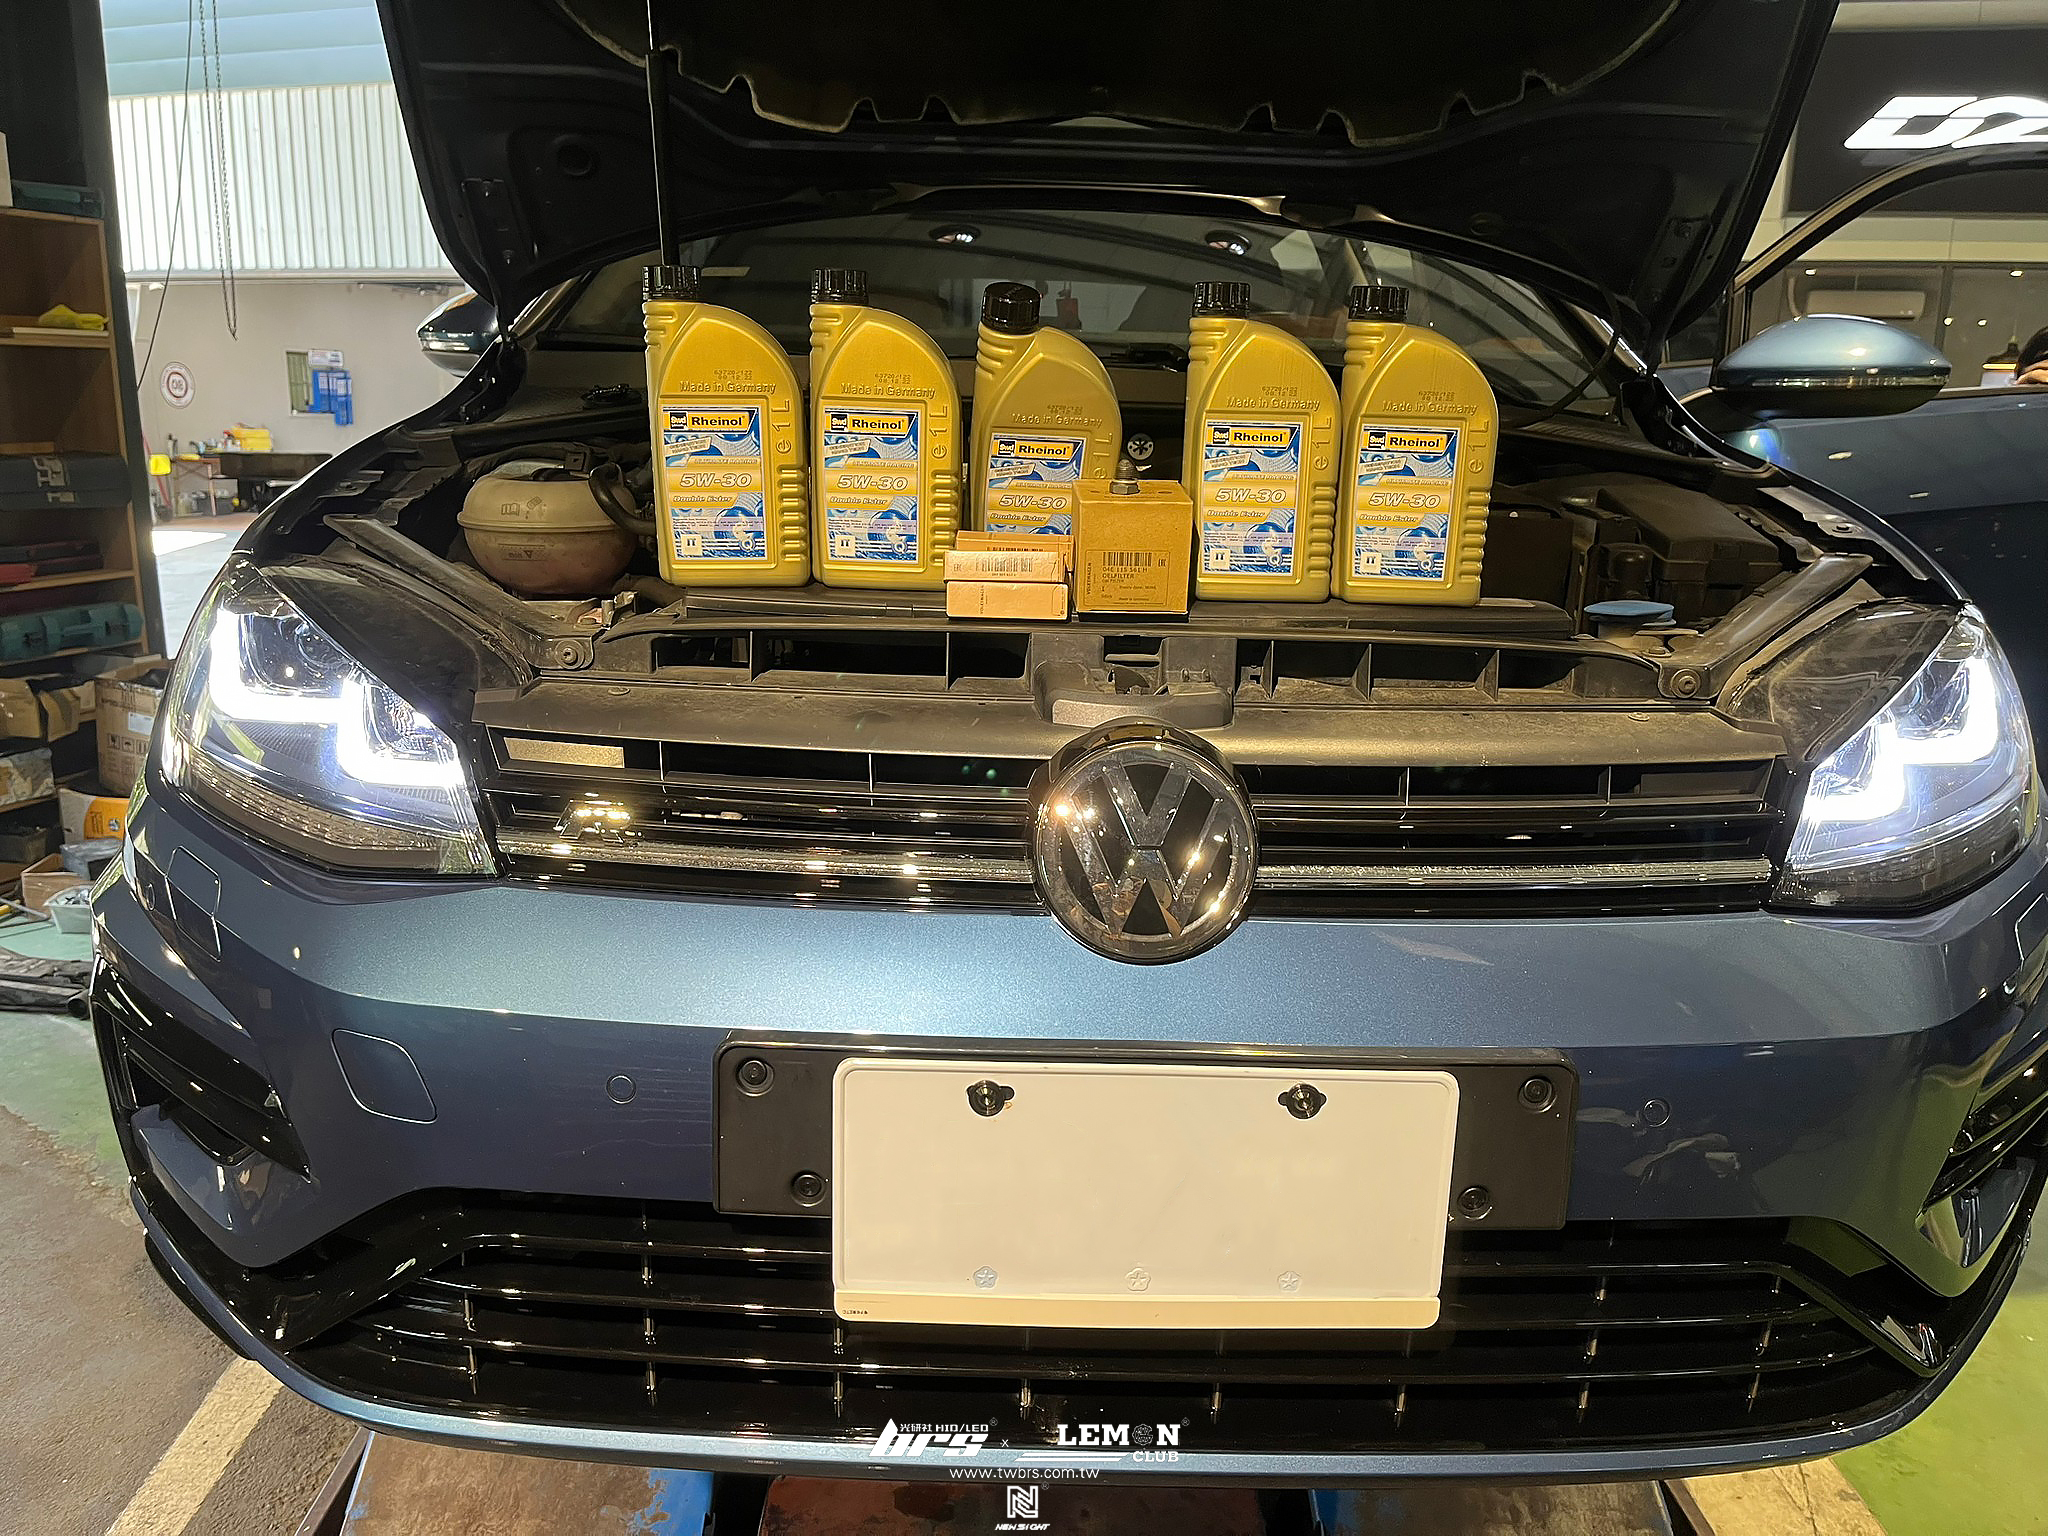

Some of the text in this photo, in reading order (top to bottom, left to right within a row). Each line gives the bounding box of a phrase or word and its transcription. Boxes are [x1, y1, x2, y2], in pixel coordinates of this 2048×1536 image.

[680, 381, 776, 395] Made in Germany
[841, 383, 936, 400] Made in Germany
[1226, 396, 1320, 411] Made in Germany
[1382, 400, 1478, 416] Made in Germany
[691, 416, 743, 426] Rheinol
[852, 418, 902, 430] Rheinol
[1011, 413, 1103, 428] Made in Germany
[1233, 432, 1283, 442] Rheinol
[1389, 437, 1440, 448] Rheinol
[1018, 444, 1067, 455] Rheinol
[680, 472, 752, 487] 5W-30
[837, 474, 908, 491] 5W-30
[673, 495, 705, 503] Double
[829, 496, 888, 505] Double Ester
[999, 494, 1067, 510] 5W-30
[1215, 487, 1287, 504] 5W-30
[1368, 492, 1441, 509] 5W-30
[989, 512, 1047, 522] Double Ester
[1207, 509, 1266, 518] Double Ester
[1359, 513, 1419, 522] Double Ester
